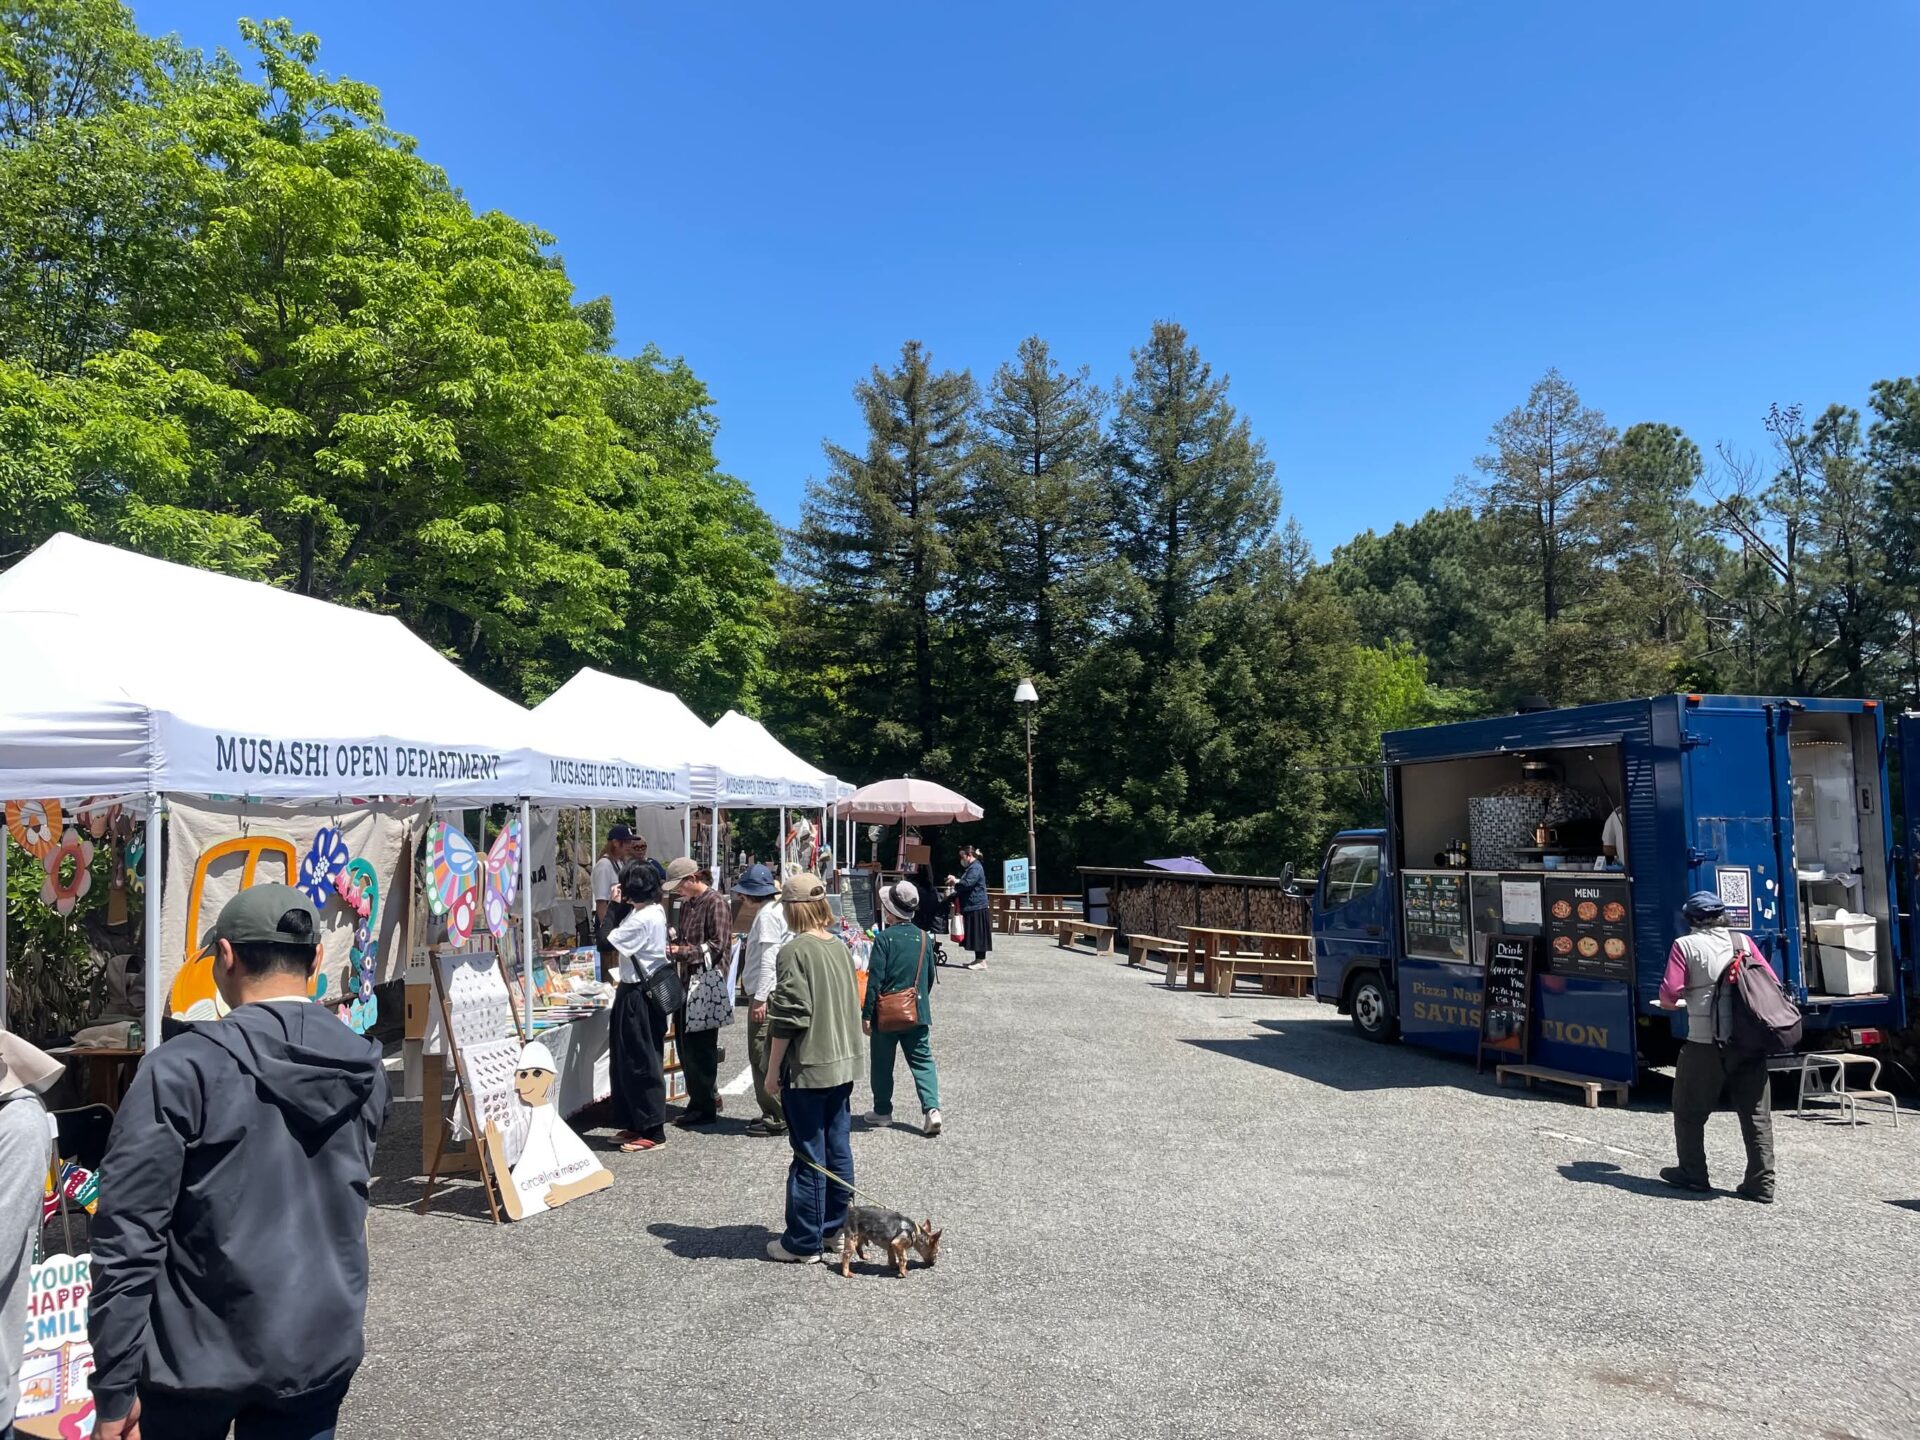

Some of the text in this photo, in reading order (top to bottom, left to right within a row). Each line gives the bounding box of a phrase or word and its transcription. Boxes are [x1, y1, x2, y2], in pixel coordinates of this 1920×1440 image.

[215, 734, 501, 780] MUSASHI OPEN DEPARTMENT
[550, 759, 676, 791] MUSASHI OPEN DEPARTMENT
[1574, 888, 1600, 898] MENU
[1497, 943, 1523, 956] Drink
[1412, 982, 1447, 998] Pizza
[29, 1260, 90, 1293] YOUR
[27, 1283, 92, 1317] HAPP
